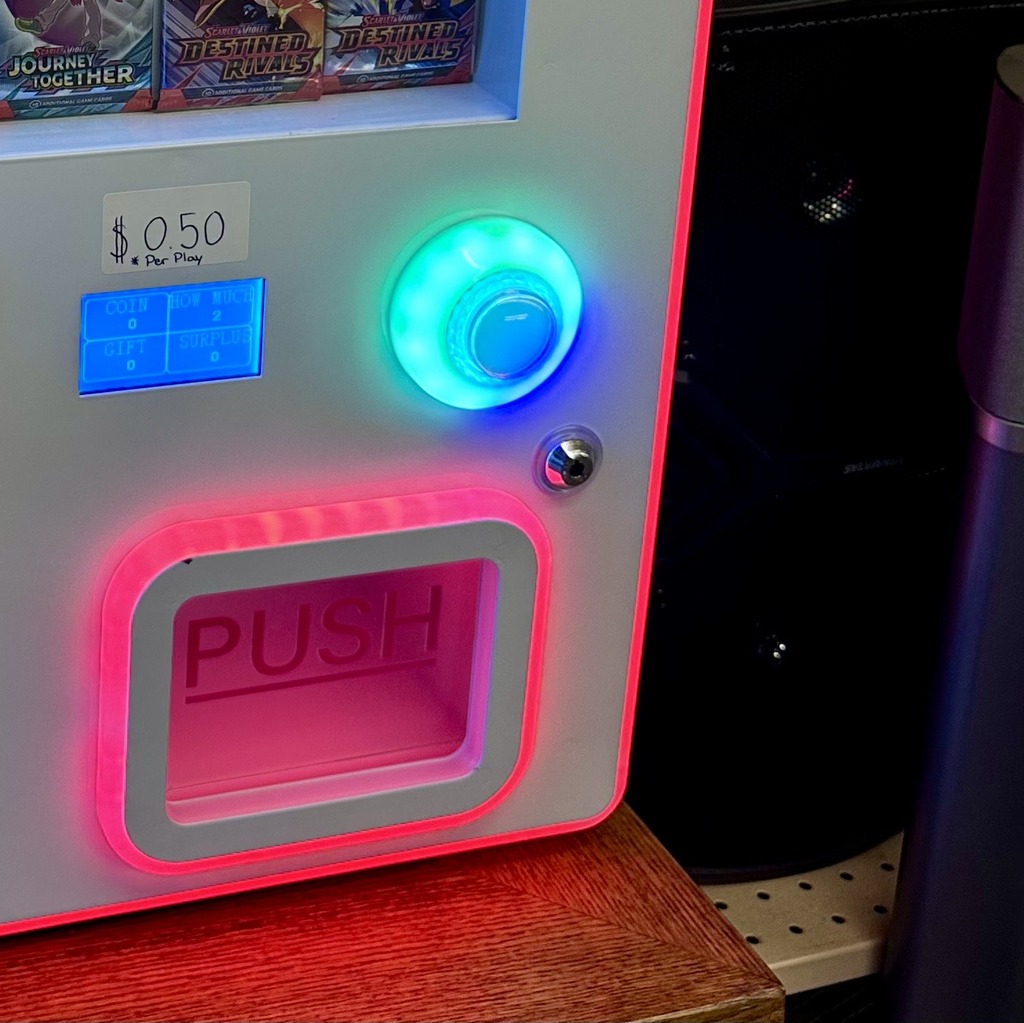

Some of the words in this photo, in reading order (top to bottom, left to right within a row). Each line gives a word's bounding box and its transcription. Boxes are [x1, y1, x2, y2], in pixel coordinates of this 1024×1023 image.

[340, 20, 458, 51] DESTINED
[182, 32, 308, 63] DESTINED
[379, 40, 462, 67] RIVALS
[8, 53, 94, 77] JOURNEY
[223, 53, 312, 80] RIVALS
[31, 64, 134, 89] TOGETHER
[144, 211, 225, 251] 0.50
[145, 253, 169, 267] Per
[174, 252, 203, 265] Play
[106, 297, 148, 315] COIN
[170, 292, 201, 309] HOW
[212, 287, 253, 304] MUCH
[128, 318, 137, 330] 0
[212, 310, 221, 322] 2
[104, 338, 147, 356] GIFT
[179, 329, 252, 350] SURPLUS
[126, 359, 136, 371] 0
[211, 351, 220, 362] 0
[185, 585, 443, 688] PUSH
